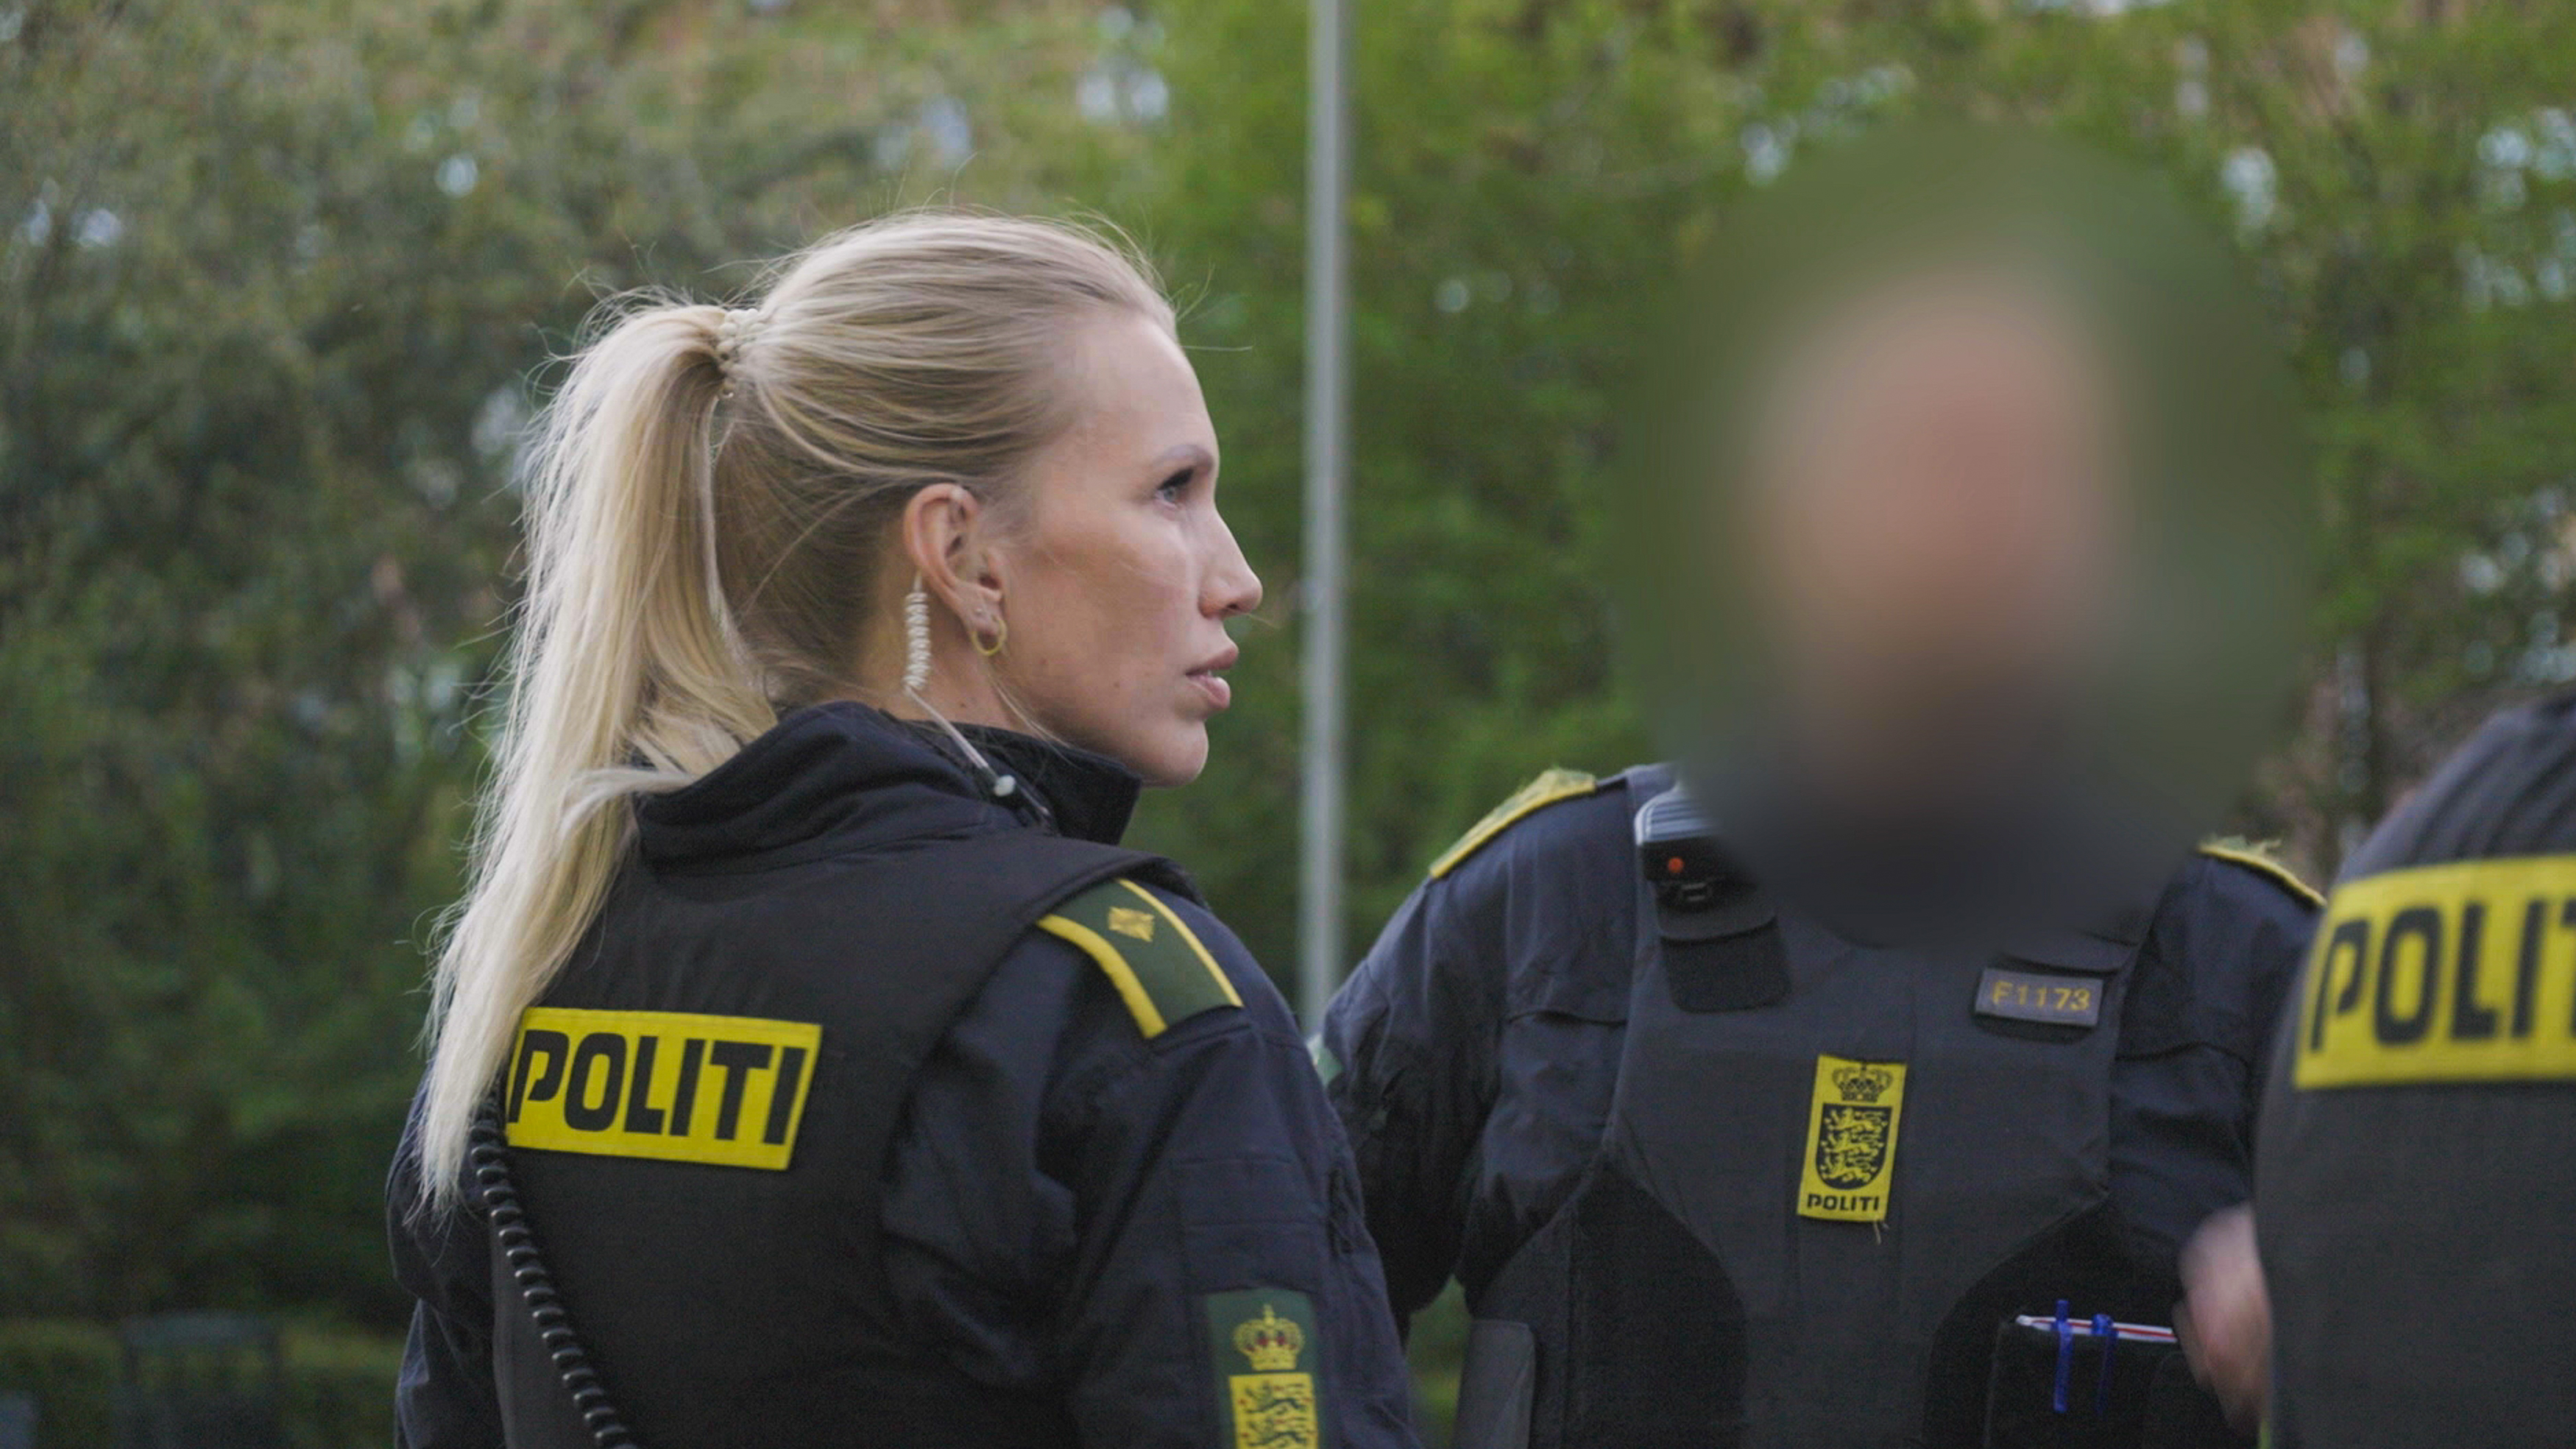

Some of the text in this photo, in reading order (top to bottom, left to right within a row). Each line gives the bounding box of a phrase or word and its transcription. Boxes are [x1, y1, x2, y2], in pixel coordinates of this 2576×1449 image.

[1992, 980, 2092, 1010] F1173
[2310, 899, 2576, 1052] POLI
[509, 1030, 807, 1145] POLITI
[1807, 1194, 1880, 1211] POLITI
